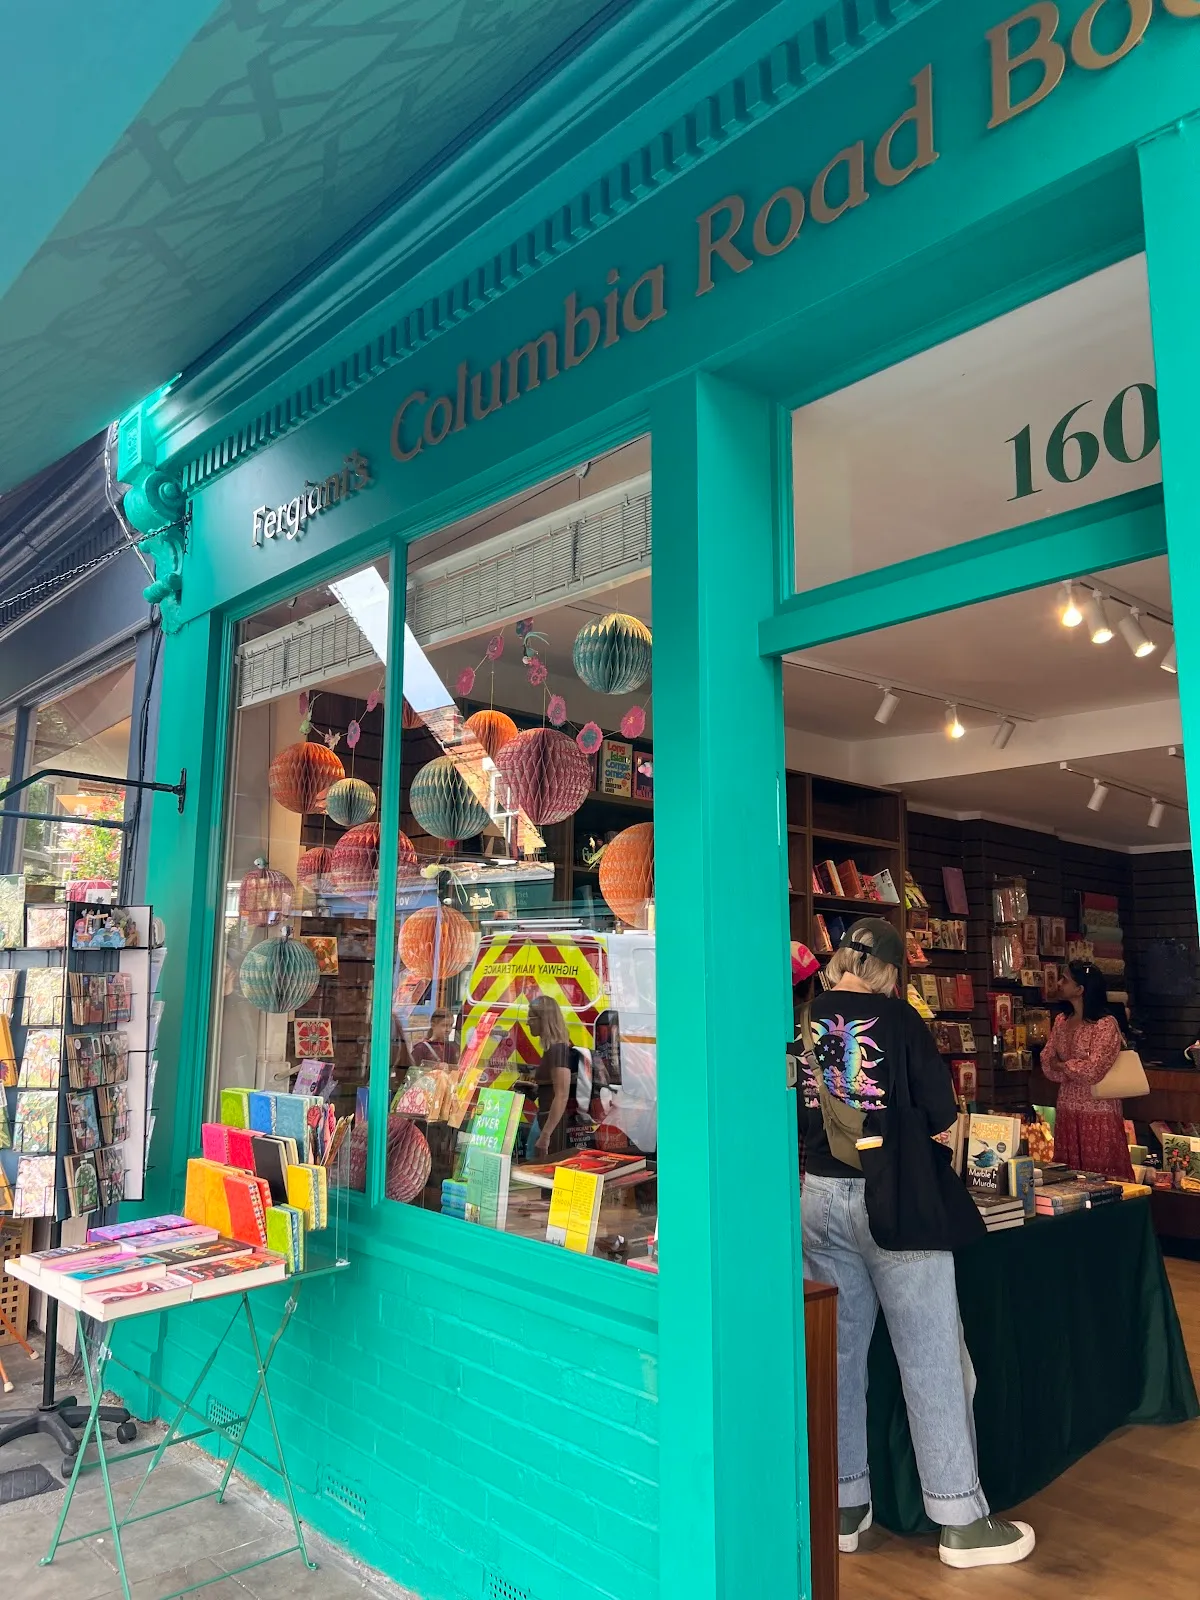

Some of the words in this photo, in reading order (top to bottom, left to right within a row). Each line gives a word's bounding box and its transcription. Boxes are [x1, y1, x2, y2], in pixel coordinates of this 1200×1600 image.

[251, 450, 371, 547] Fergiani's
[390, 264, 667, 461] Columbia
[695, 63, 940, 298] Road
[1004, 383, 1161, 501] 160
[608, 742, 625, 755] Long
[476, 1116, 500, 1130] RIVER
[470, 1134, 498, 1148] ALIVE?
[969, 1169, 991, 1179] Marble
